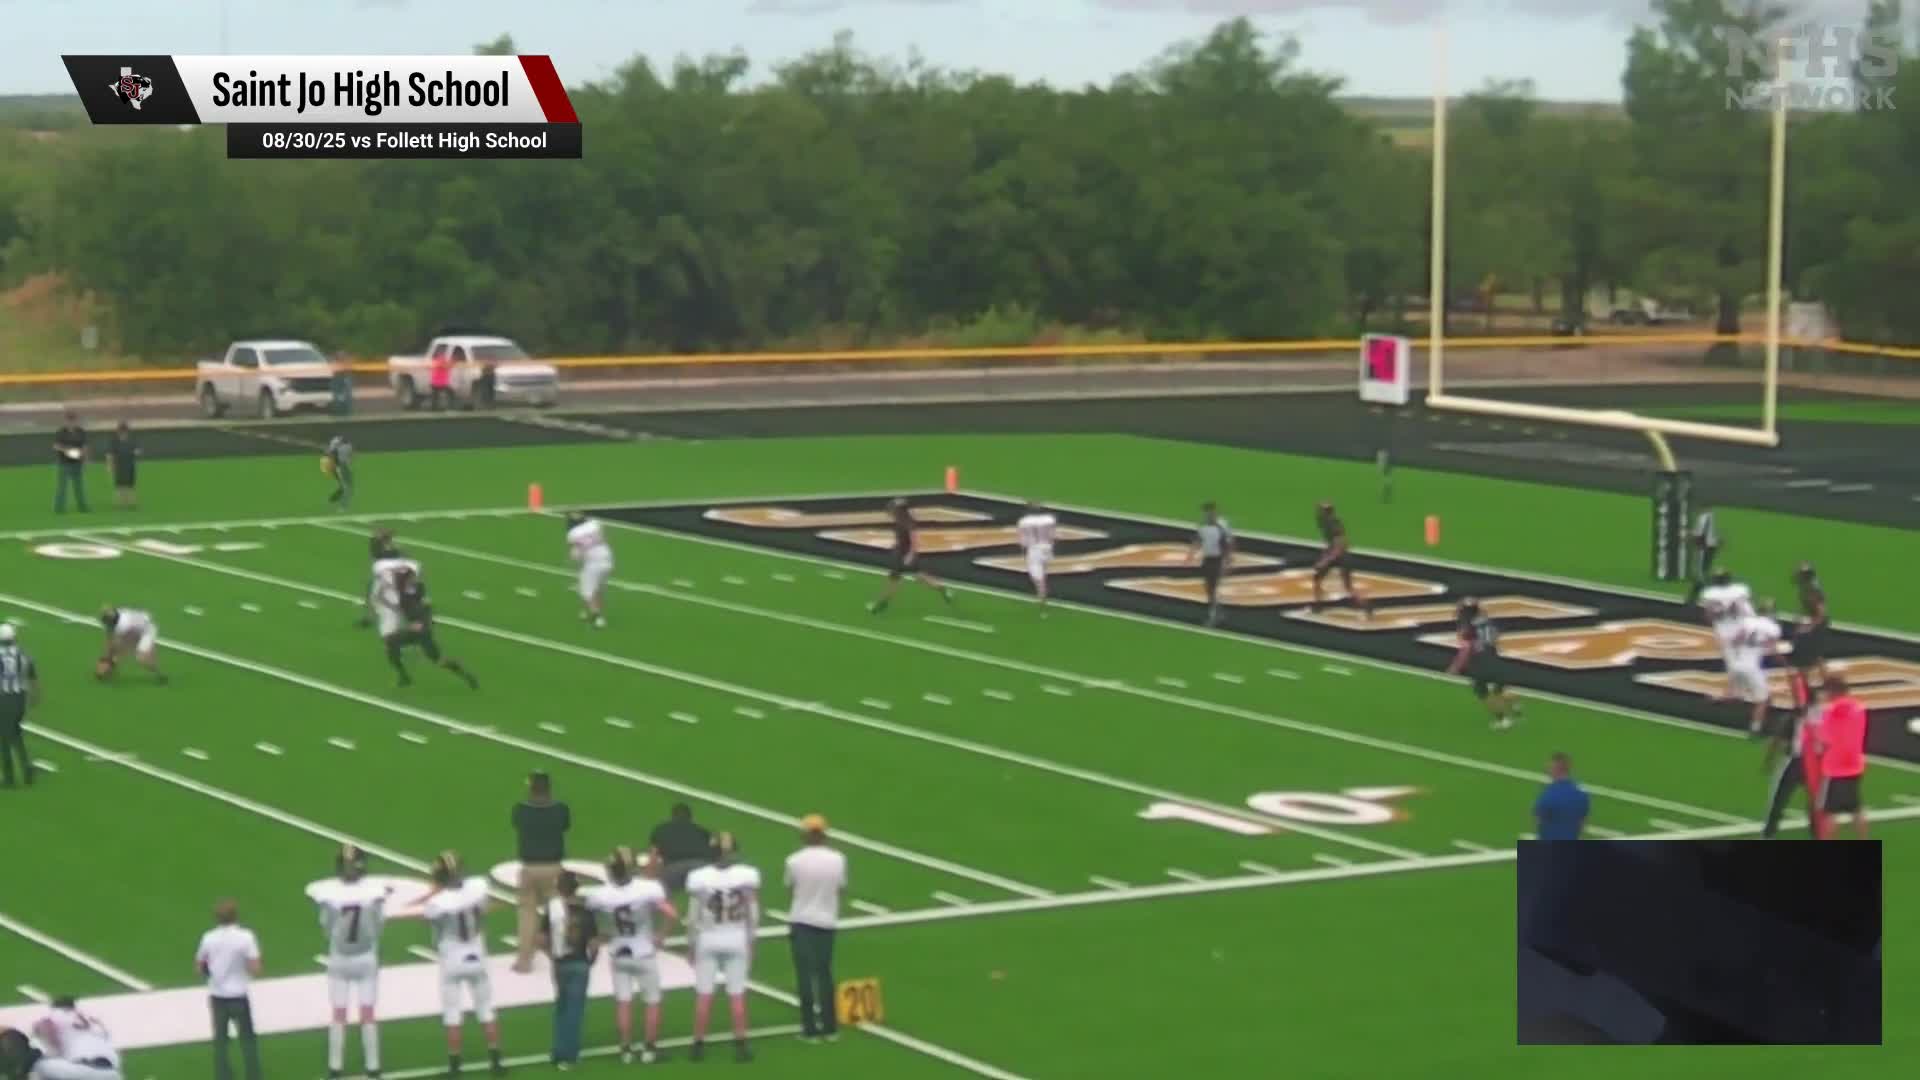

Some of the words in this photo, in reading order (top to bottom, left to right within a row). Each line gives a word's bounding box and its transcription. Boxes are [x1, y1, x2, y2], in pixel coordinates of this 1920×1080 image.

[1136, 790, 1400, 836] 10
[340, 902, 363, 944] 7
[708, 887, 748, 925] 42
[846, 983, 875, 1022] 20
